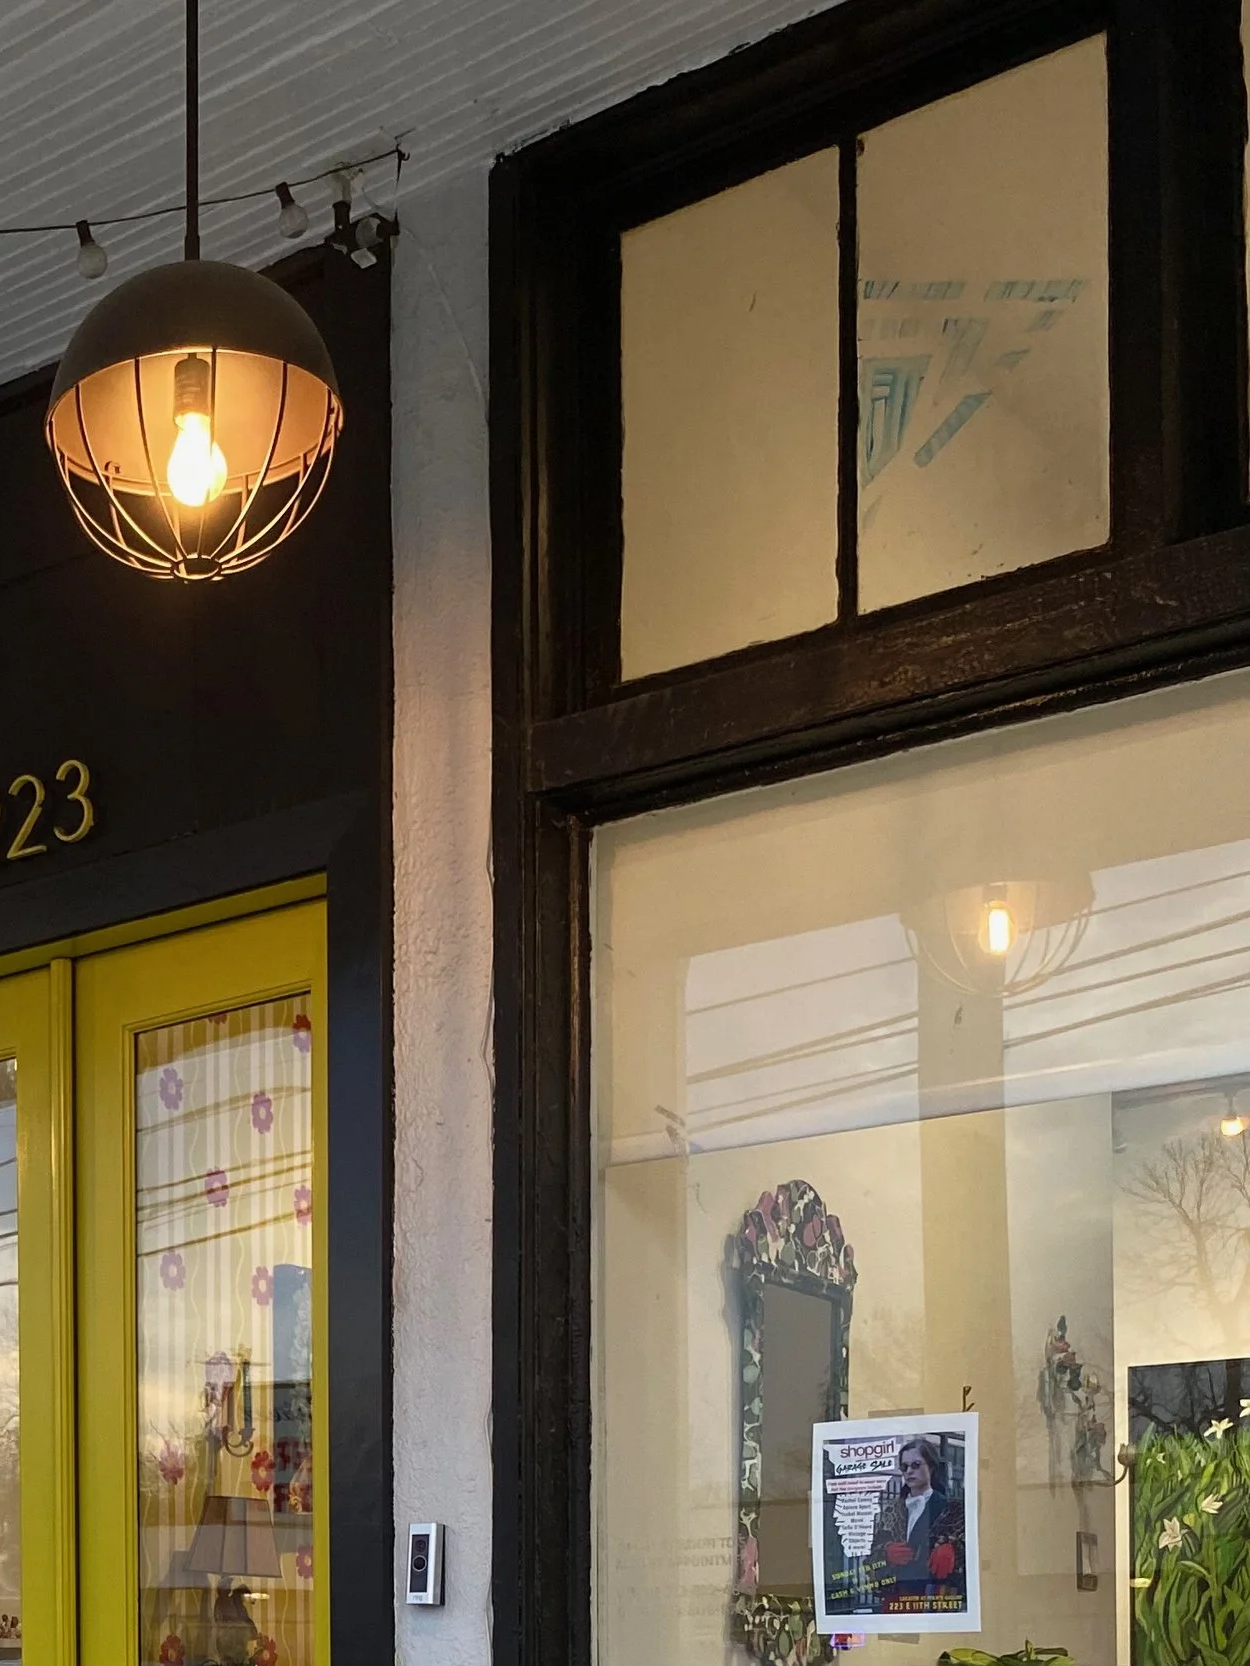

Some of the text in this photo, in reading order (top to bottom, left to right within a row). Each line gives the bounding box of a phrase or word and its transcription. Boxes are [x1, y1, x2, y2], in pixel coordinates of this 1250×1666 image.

[840, 1440, 894, 1459] shopgirl
[835, 1459, 892, 1475] GARAGE SALE
[889, 1601, 963, 1611] 223 E 11TH STREET
